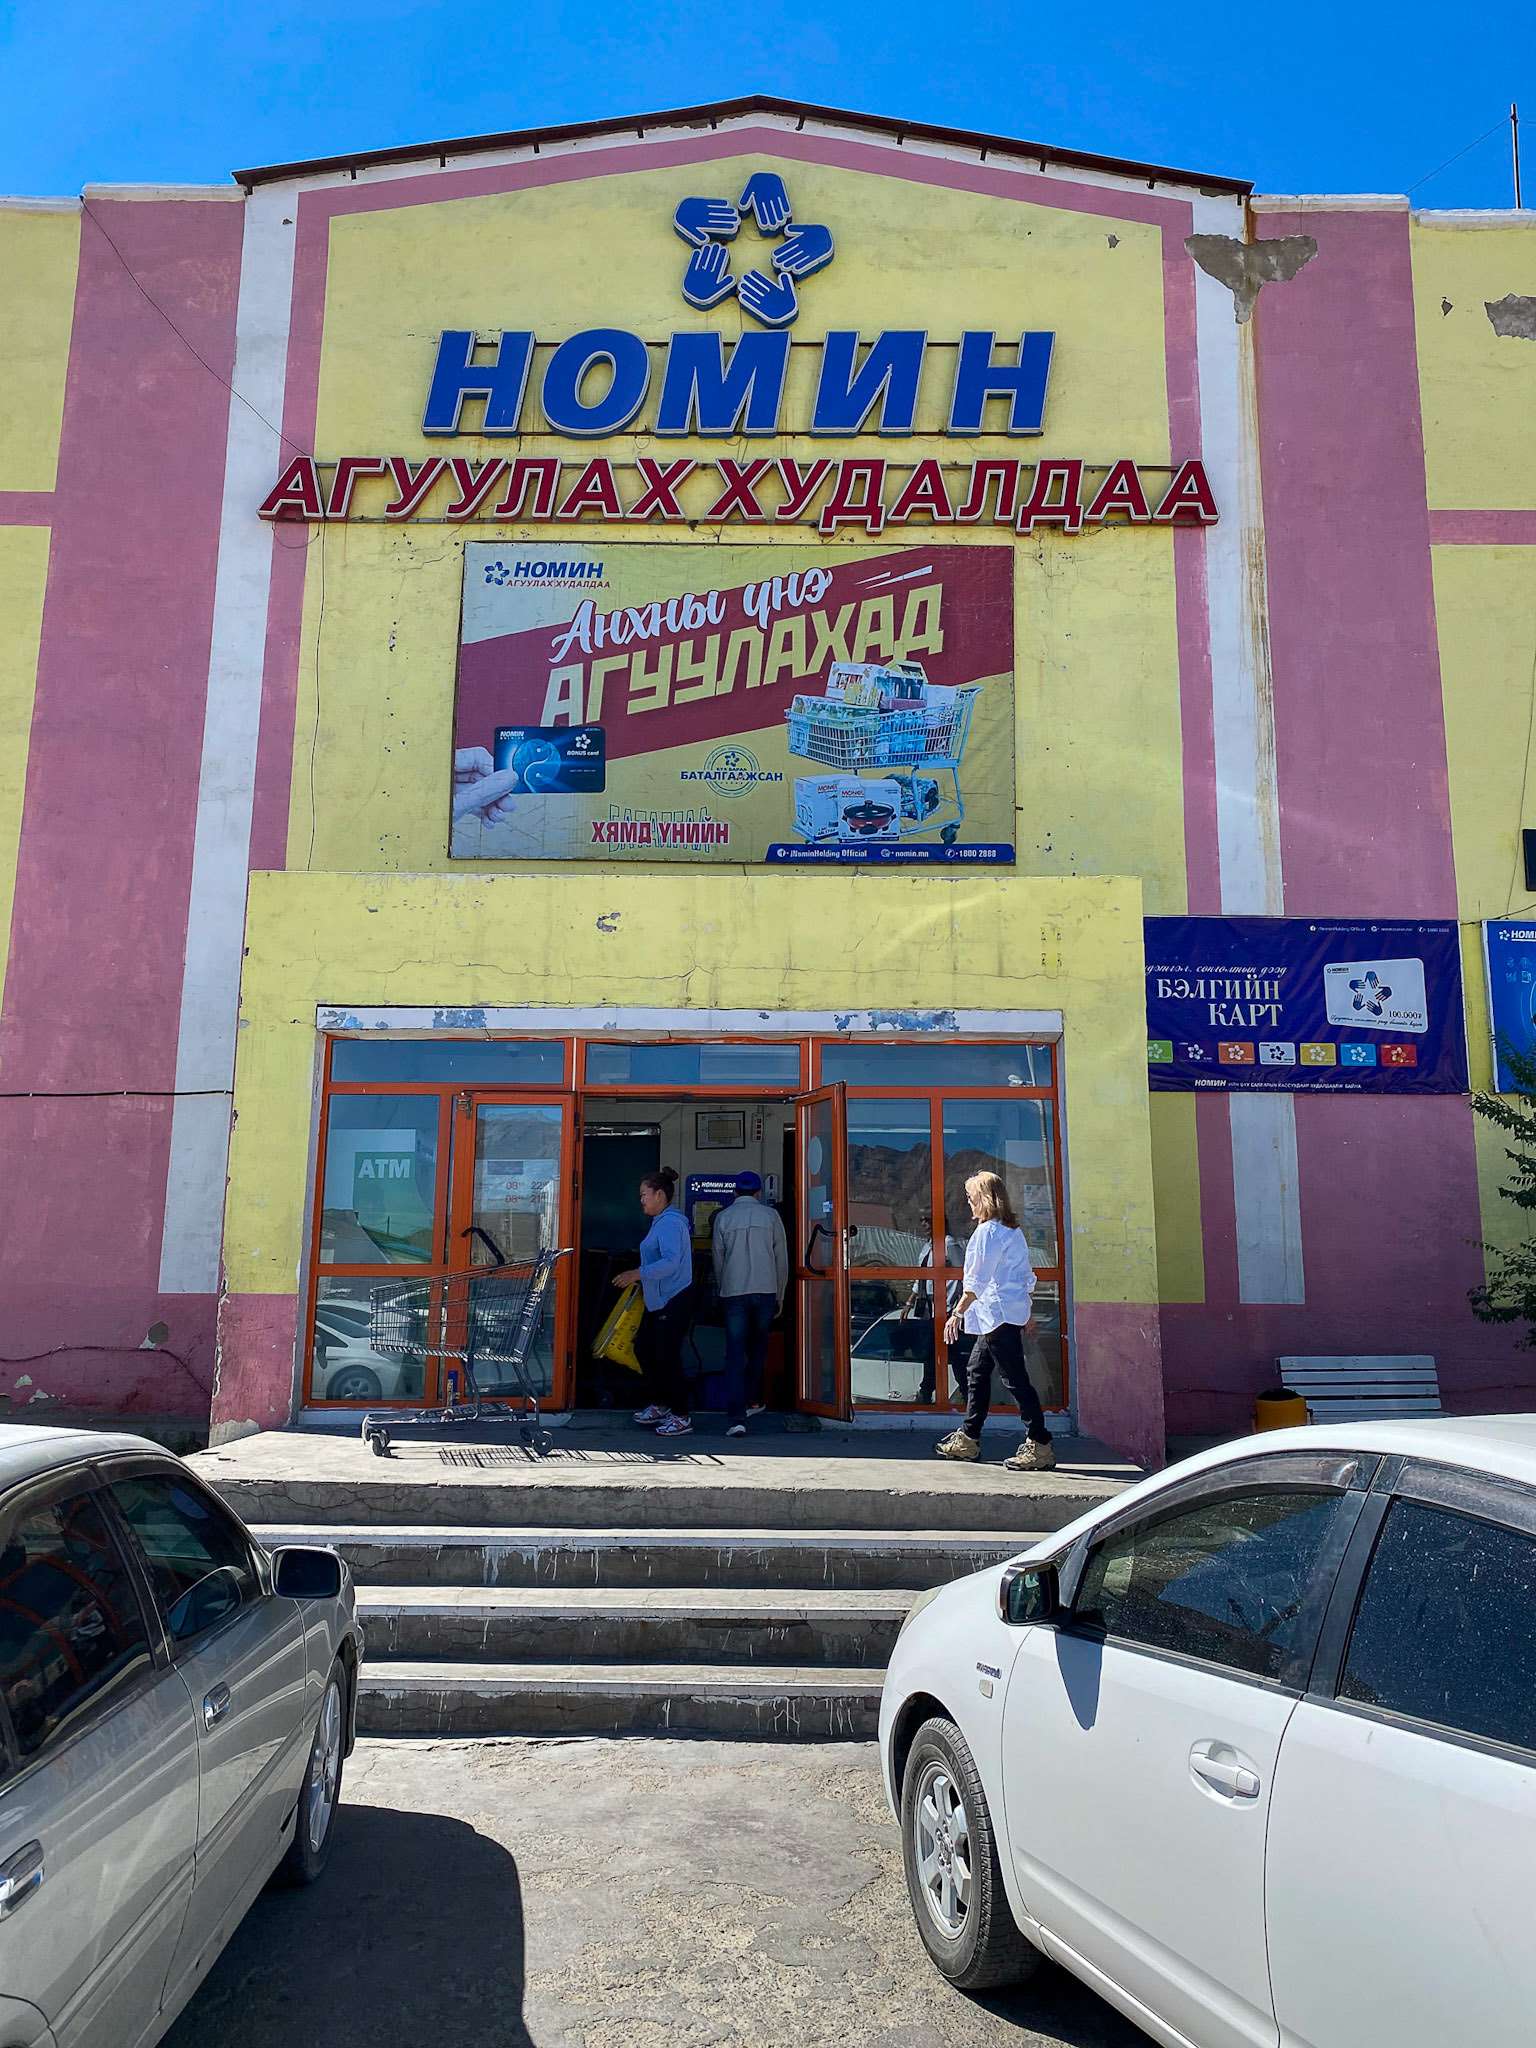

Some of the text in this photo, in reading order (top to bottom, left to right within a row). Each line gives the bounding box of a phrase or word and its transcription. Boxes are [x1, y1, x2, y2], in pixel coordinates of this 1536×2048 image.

[421, 328, 1056, 439] НОМИН
[257, 455, 1220, 536] АГУУЛАХ ХУДАЛДАА
[513, 561, 604, 579] НОМИН
[506, 579, 611, 589] АГУУЛАХ ХУДАЛДАА
[548, 589, 727, 664] Анхны
[539, 583, 944, 728] АГУУЛАХАД
[680, 771, 783, 782] БАТАЛГААЖСАН
[591, 816, 730, 844] ХЯМД ҮНИЙН
[841, 849, 867, 857] Official
[895, 849, 929, 857] nomin.mn
[959, 849, 977, 857] 1800
[1511, 930, 1536, 939] НОМ
[1156, 973, 1281, 1000] БЭЛГИЙН
[1207, 1003, 1284, 1027] КАРТ
[1194, 1079, 1227, 1087] НОМИН
[358, 1158, 411, 1179] ATM
